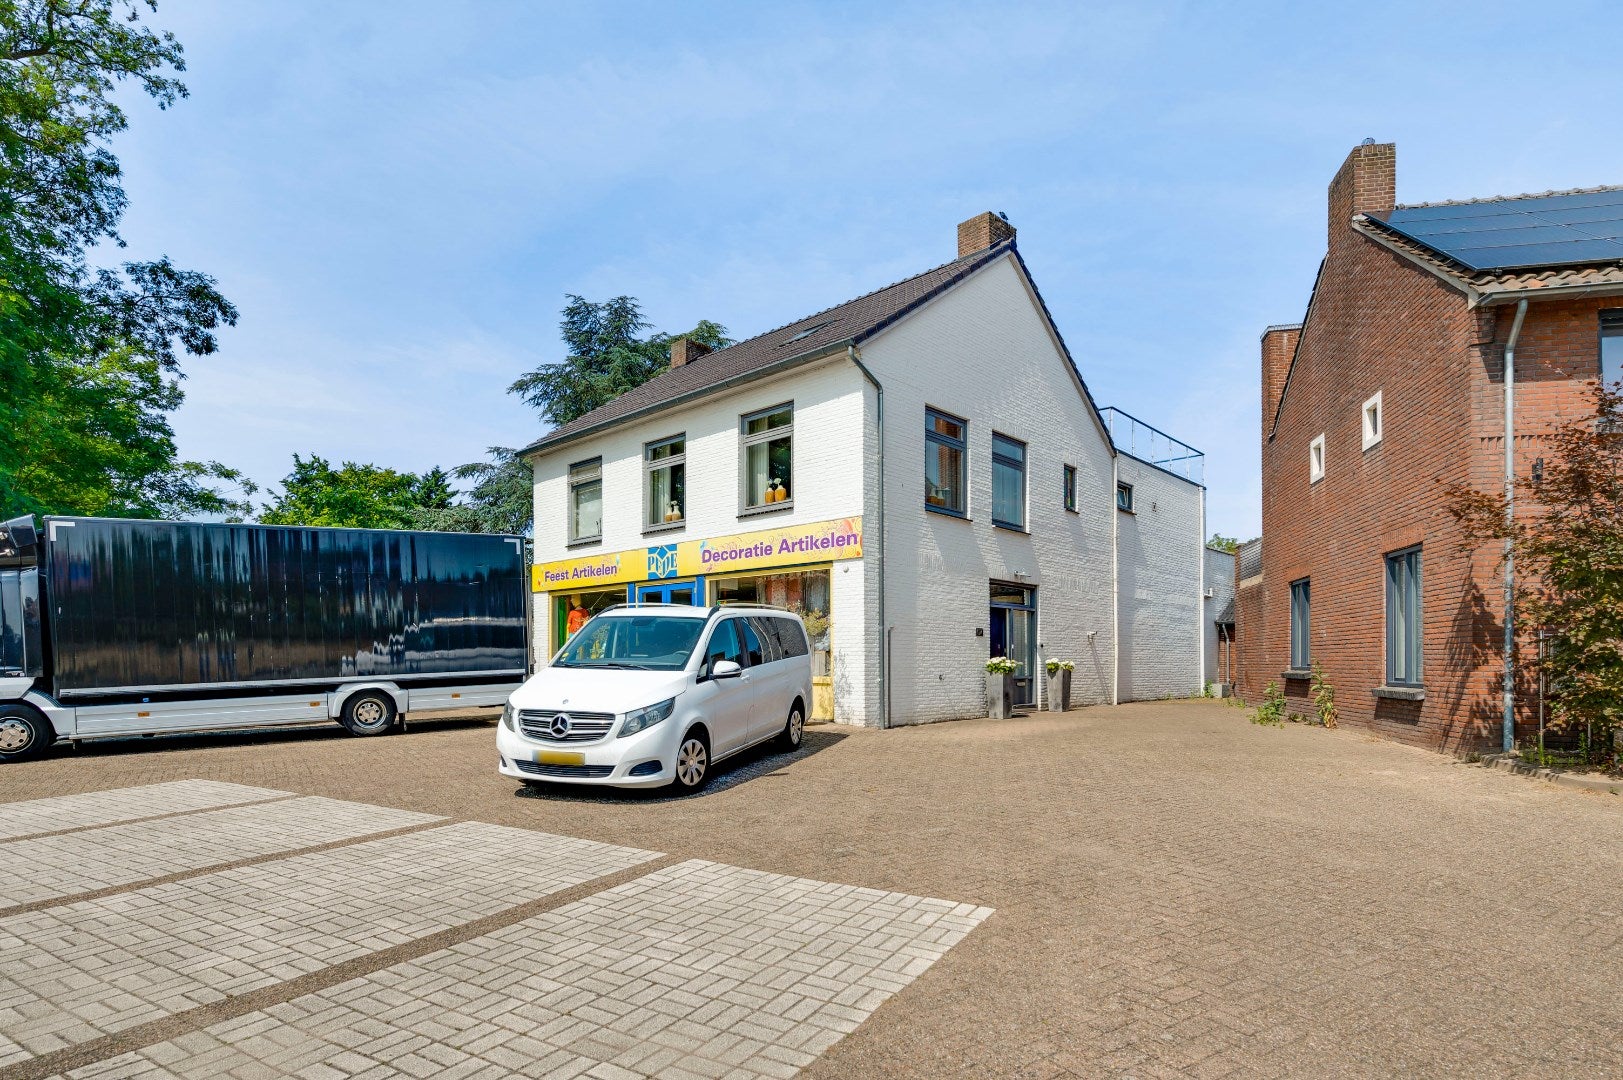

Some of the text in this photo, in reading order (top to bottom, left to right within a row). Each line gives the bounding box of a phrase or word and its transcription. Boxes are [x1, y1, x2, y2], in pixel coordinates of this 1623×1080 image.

[702, 532, 858, 563] Decoratie Artikelen
[544, 564, 618, 582] Feest Artikelen
